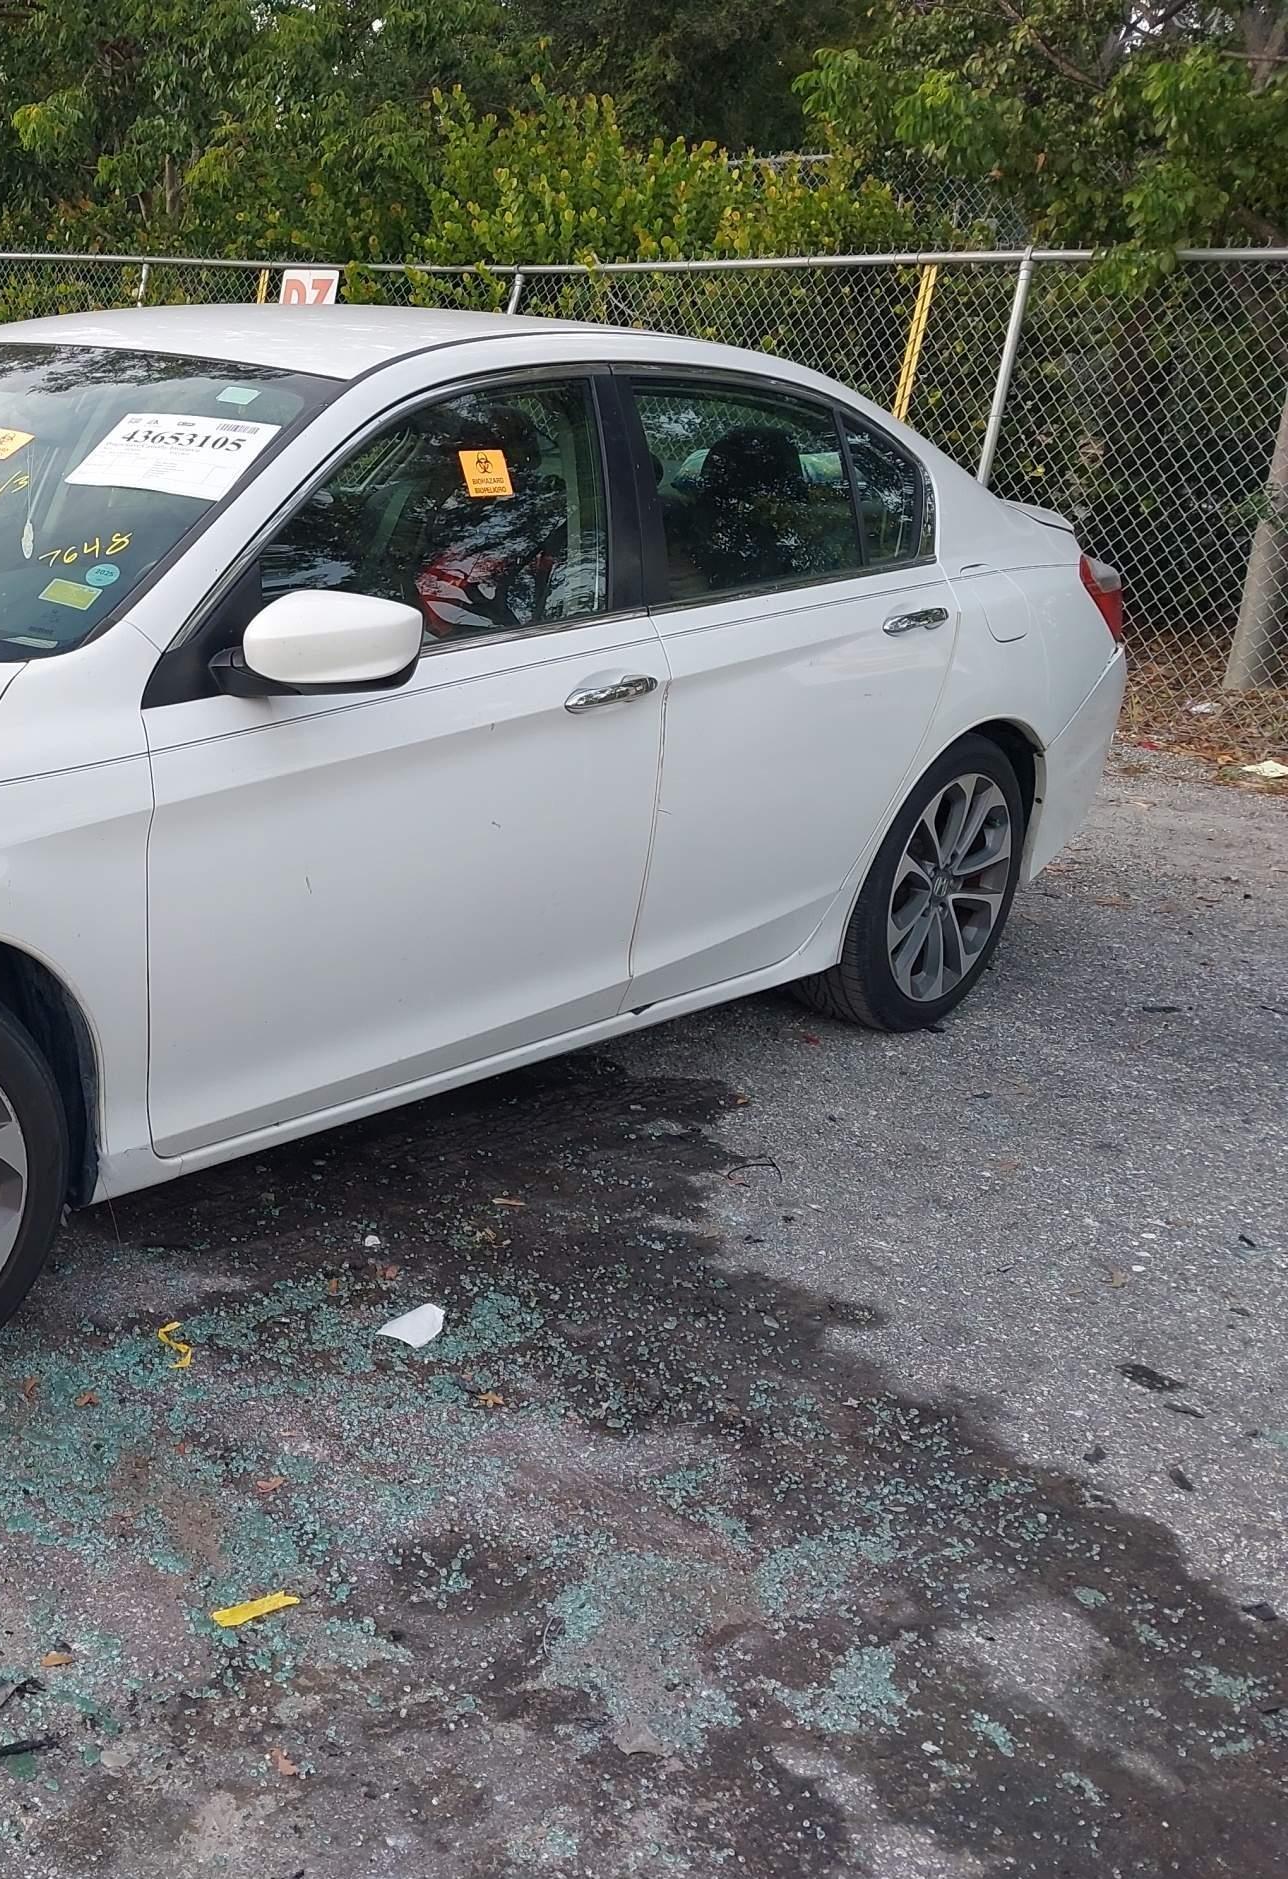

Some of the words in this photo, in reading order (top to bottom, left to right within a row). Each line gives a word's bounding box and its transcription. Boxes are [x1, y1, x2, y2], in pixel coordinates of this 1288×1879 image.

[121, 428, 247, 452] 43653105
[471, 477, 504, 485] BIOHAZARD
[38, 532, 133, 568] 7648
